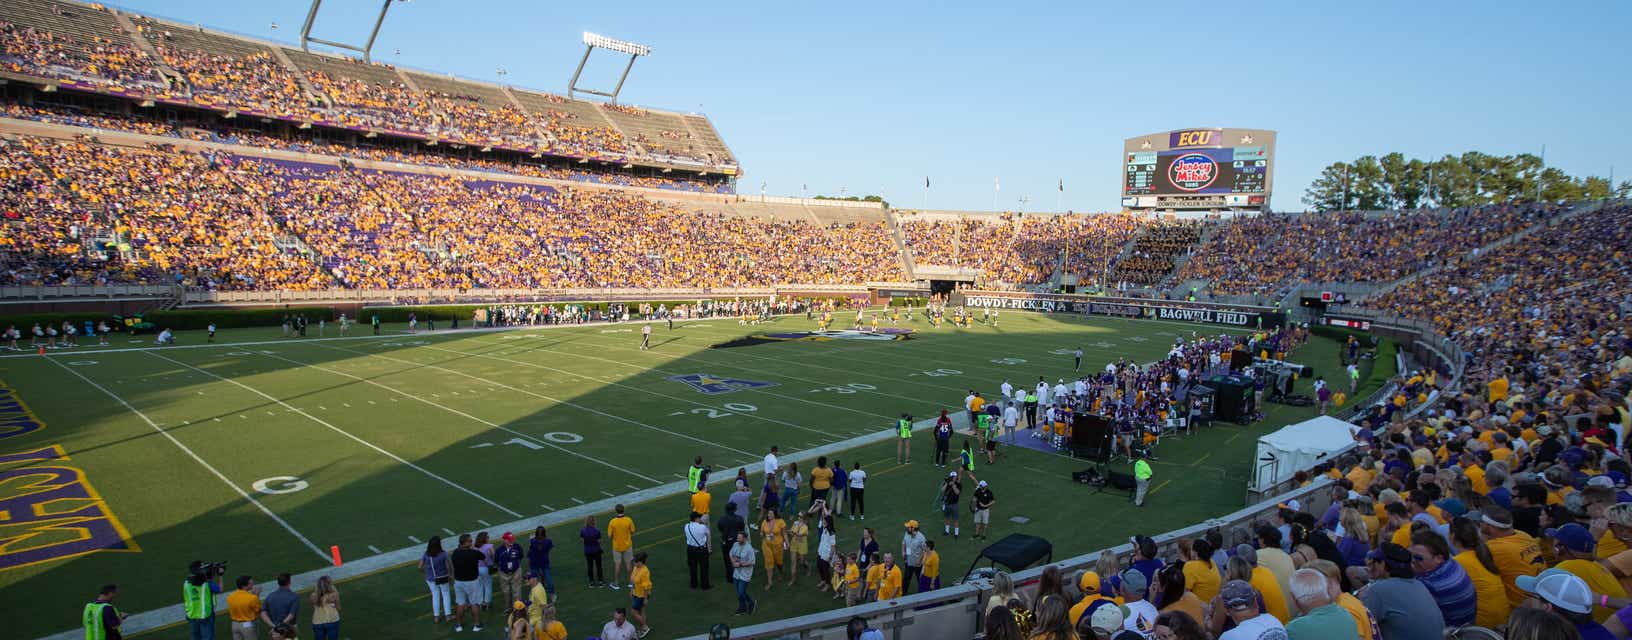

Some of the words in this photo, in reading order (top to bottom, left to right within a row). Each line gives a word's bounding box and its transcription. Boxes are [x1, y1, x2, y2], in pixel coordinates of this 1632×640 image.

[1179, 132, 1212, 146] ECU
[1175, 160, 1212, 173] Jersey
[967, 297, 1055, 311] DOWDY-FICKEN
[1160, 308, 1214, 323] BAGWELL
[1216, 313, 1248, 325] FIELD
[826, 383, 877, 394] 30
[690, 403, 758, 419] 20
[939, 423, 949, 433] 45
[502, 431, 584, 450] 10
[252, 475, 310, 495] G
